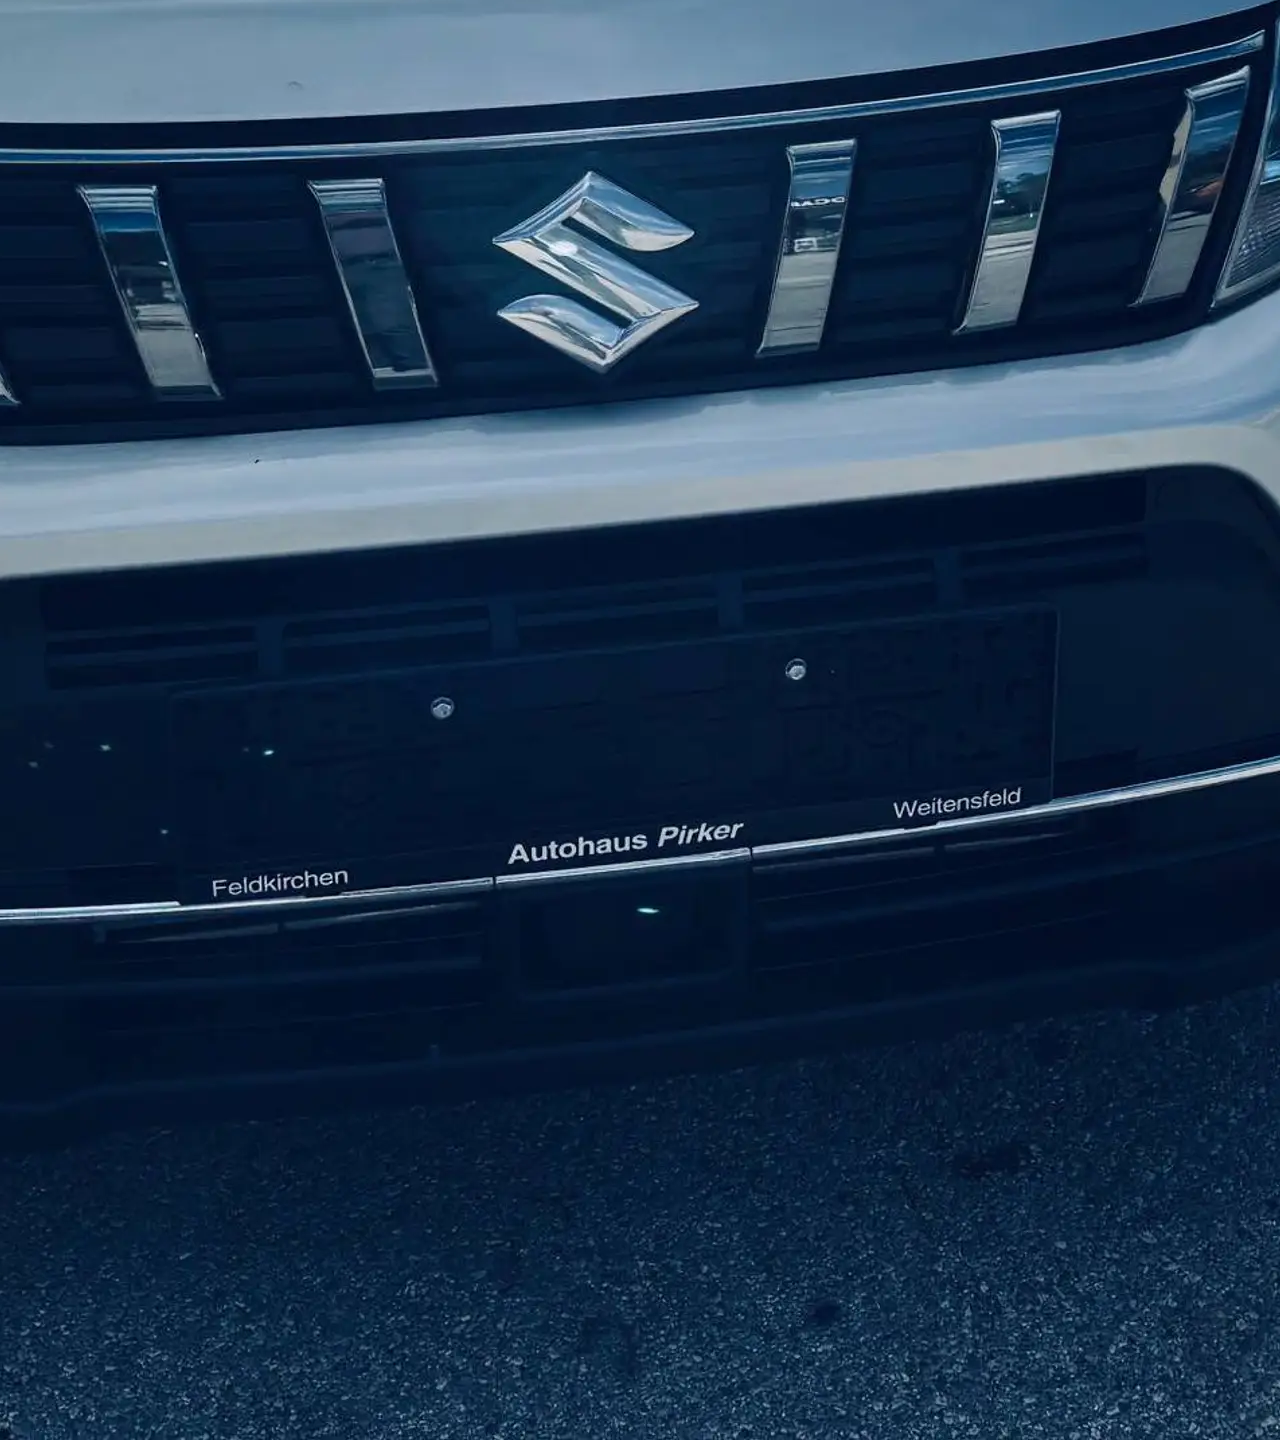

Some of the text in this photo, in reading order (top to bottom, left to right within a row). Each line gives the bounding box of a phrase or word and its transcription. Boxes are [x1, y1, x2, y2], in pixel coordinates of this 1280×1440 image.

[893, 787, 1022, 819] Weitensfeld
[507, 822, 744, 864] Autohaus Pirker
[212, 870, 348, 897] Feldkirchen
